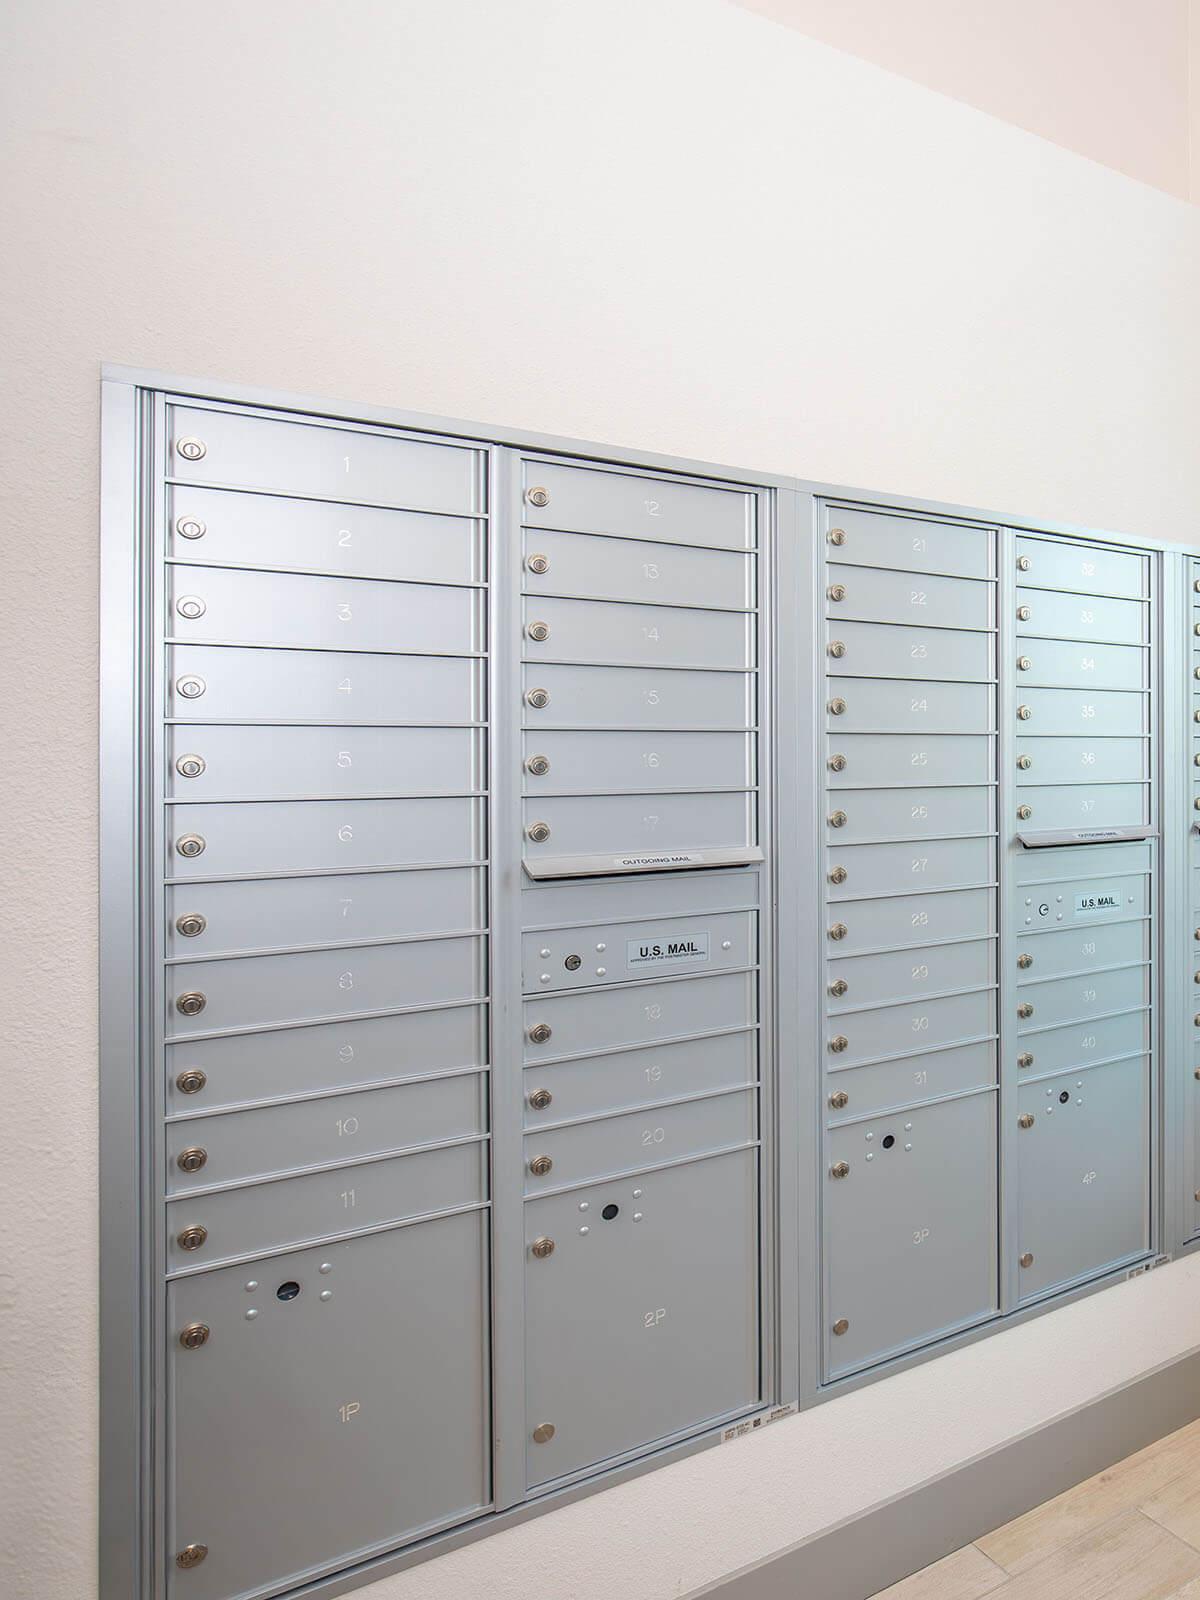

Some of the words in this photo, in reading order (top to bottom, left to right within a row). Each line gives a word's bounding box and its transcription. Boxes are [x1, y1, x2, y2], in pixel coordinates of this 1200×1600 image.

[344, 457, 349, 472] 1
[339, 530, 352, 546] 2
[912, 537, 926, 551] 21
[643, 563, 660, 579] 13
[911, 592, 926, 604] 22
[338, 604, 352, 620] 3
[643, 627, 660, 642] 14
[911, 645, 926, 657] 23
[1081, 658, 1094, 670] 34
[338, 678, 352, 694] 4
[912, 699, 928, 711] 24
[1082, 706, 1094, 717] 35
[338, 752, 351, 767] 5
[912, 753, 927, 765] 25
[1082, 753, 1095, 764] 36
[912, 806, 927, 817] 26
[1081, 800, 1095, 811] 37
[339, 825, 352, 841] 6
[622, 857, 670, 865] OUTGOING
[912, 859, 927, 872] 27
[340, 899, 353, 917] 7
[1081, 898, 1097, 908] U.S.
[1097, 897, 1115, 906] MAIL
[912, 912, 928, 926] 28
[639, 945, 664, 958] U.S.
[668, 942, 698, 954] MAIL
[1082, 943, 1095, 955] 38
[912, 964, 928, 978] 29
[339, 972, 353, 989] 8
[912, 1017, 928, 1031] 30
[1082, 1036, 1096, 1048] 40
[340, 1043, 354, 1062] 9
[644, 1064, 662, 1082] 19
[914, 1070, 927, 1084] 31
[336, 1118, 358, 1136] 10
[642, 1128, 664, 1145] 20
[1083, 1172, 1096, 1184] 4P
[341, 1189, 355, 1208] 11
[914, 1229, 929, 1244] 3P
[645, 1308, 665, 1327] 2P
[339, 1403, 360, 1422] 1P
